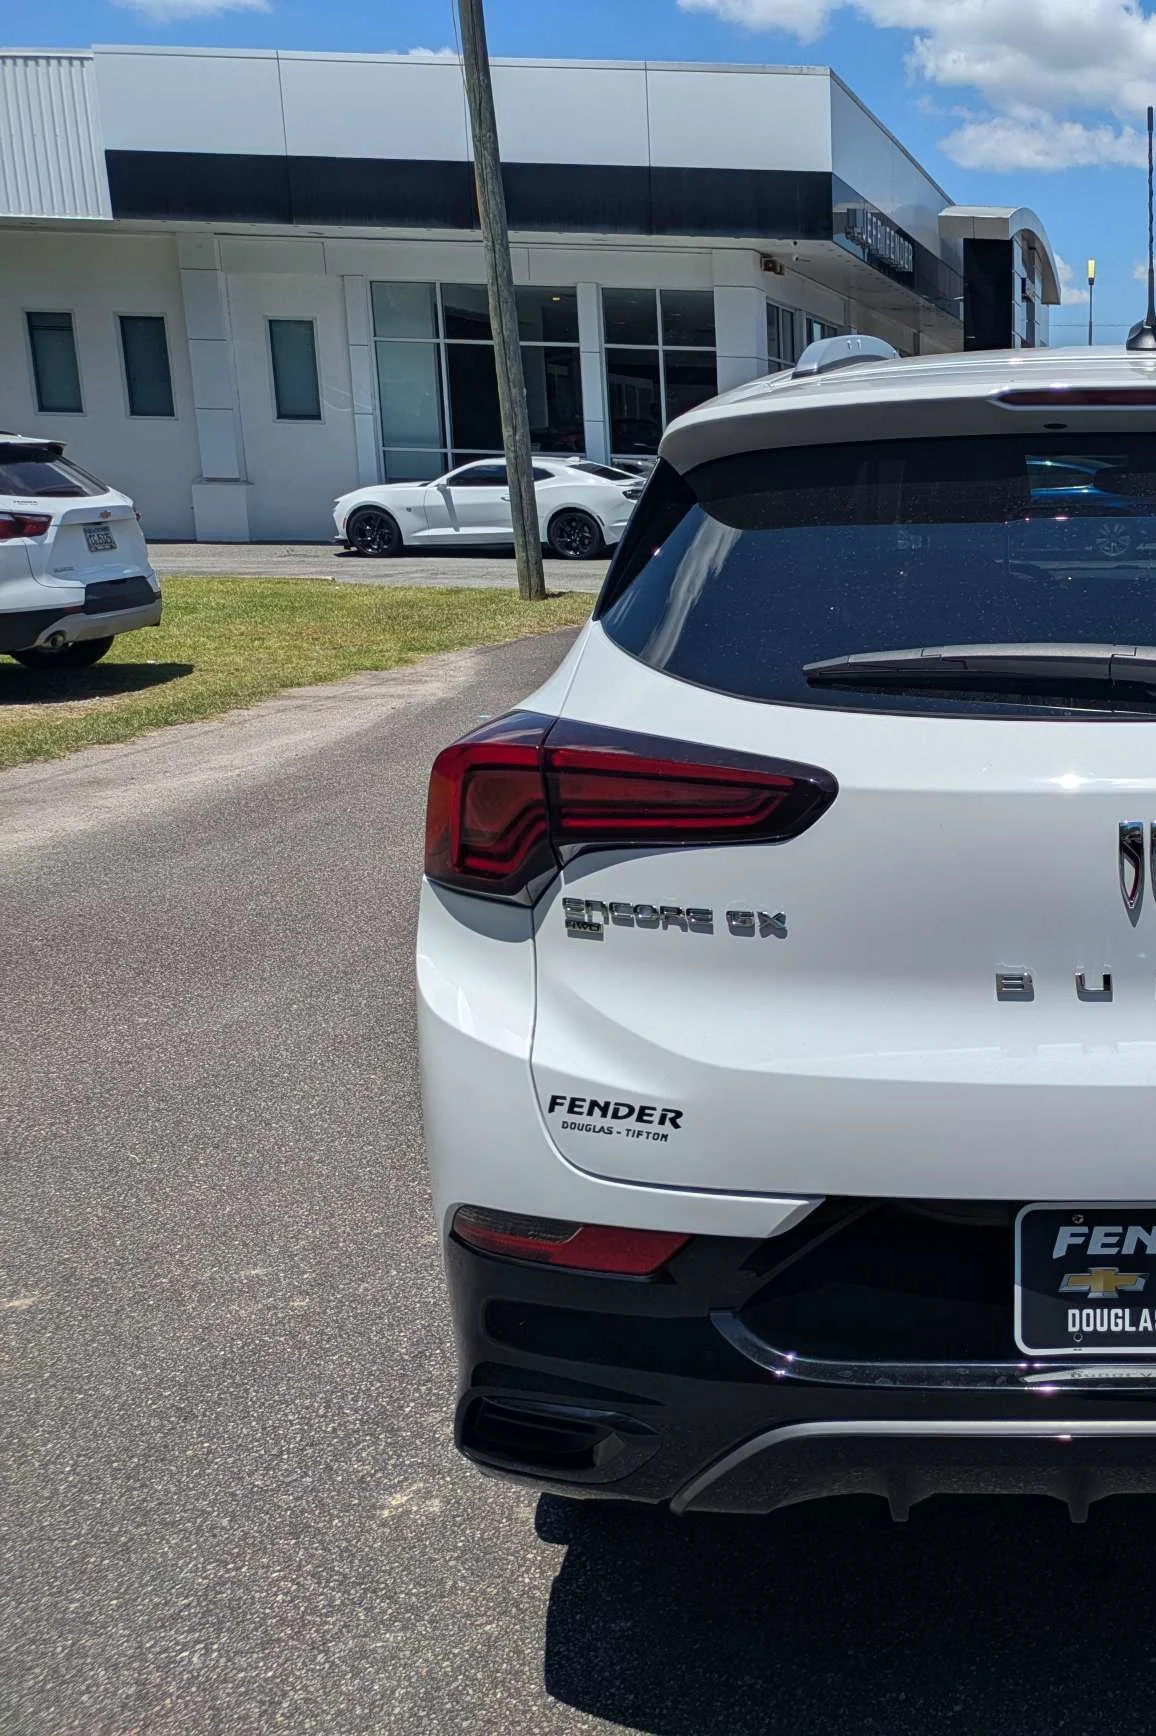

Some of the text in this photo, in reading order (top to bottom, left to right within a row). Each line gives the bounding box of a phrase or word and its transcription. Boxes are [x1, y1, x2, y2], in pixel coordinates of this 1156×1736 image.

[562, 897, 788, 937] ENCORE GX
[548, 1094, 684, 1129] FENDER
[561, 1120, 614, 1135] DOUGLAS
[625, 1128, 669, 1142] TIFTON
